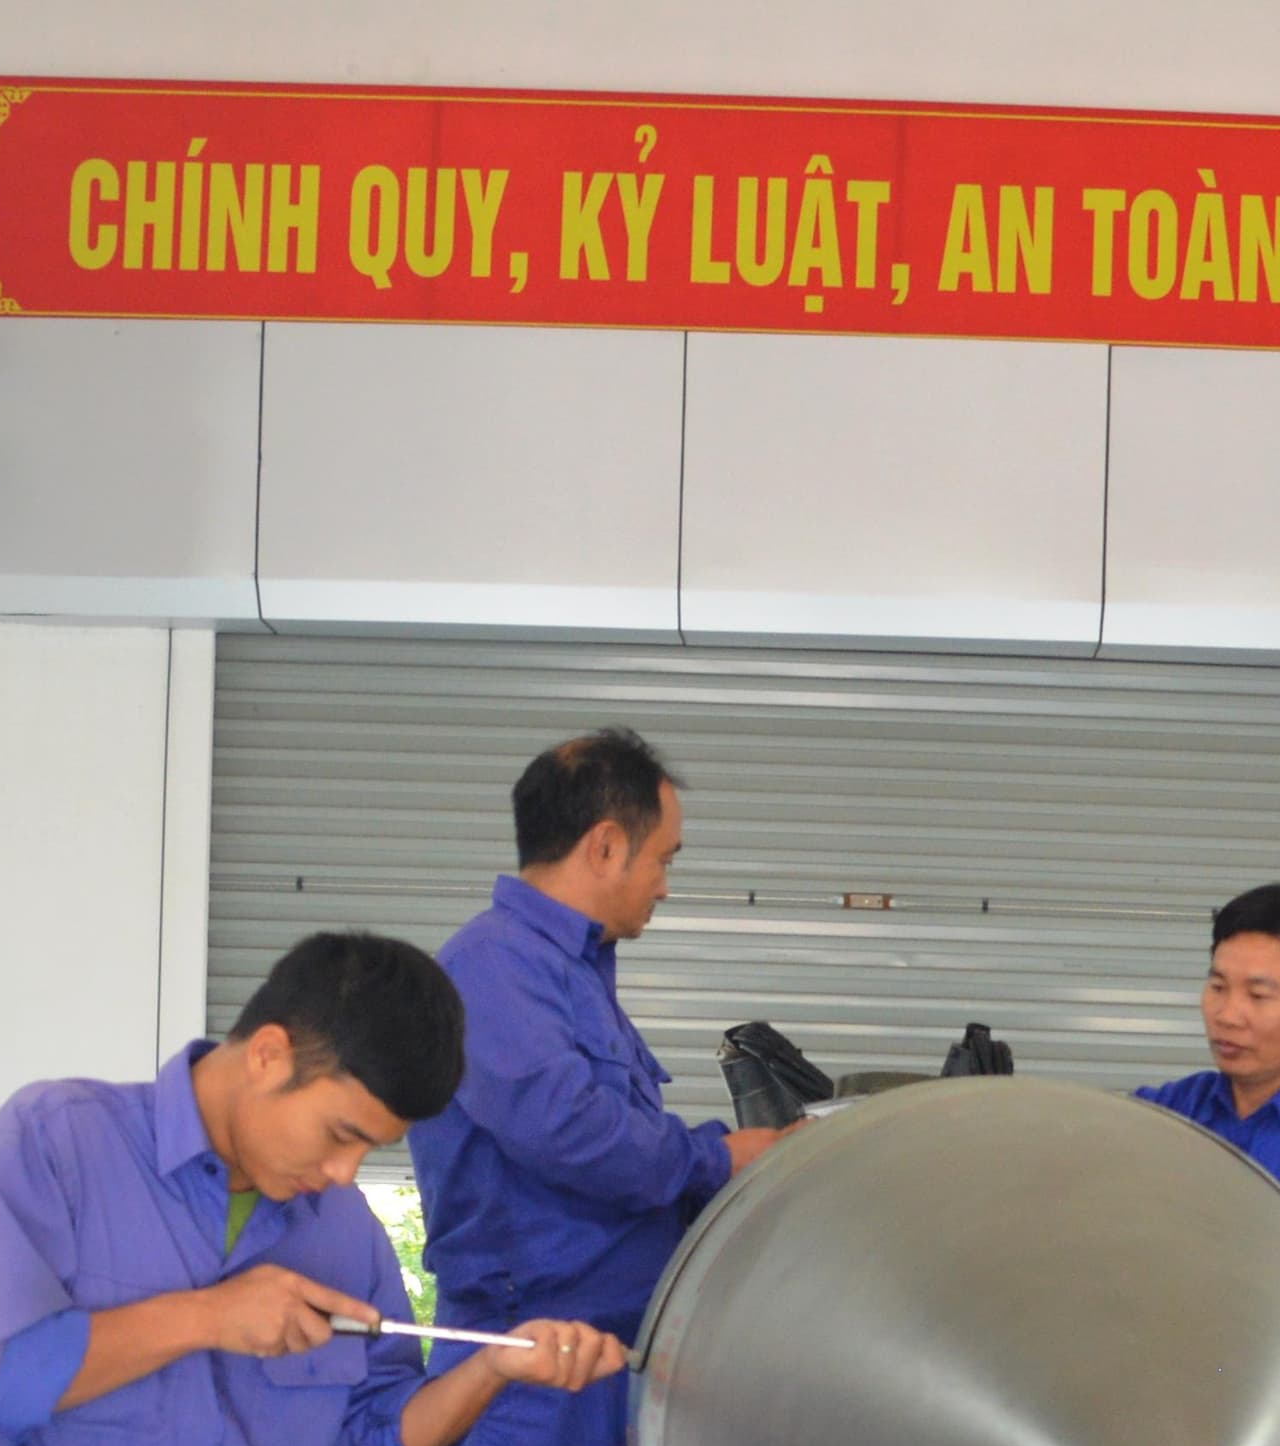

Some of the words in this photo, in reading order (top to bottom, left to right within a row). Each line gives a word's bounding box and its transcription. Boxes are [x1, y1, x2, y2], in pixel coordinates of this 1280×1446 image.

[69, 137, 321, 273] CHÍNH
[349, 164, 529, 294] QUY,
[559, 124, 665, 282] KỶ
[690, 154, 910, 313] LUẬT,
[938, 183, 1054, 294] AN
